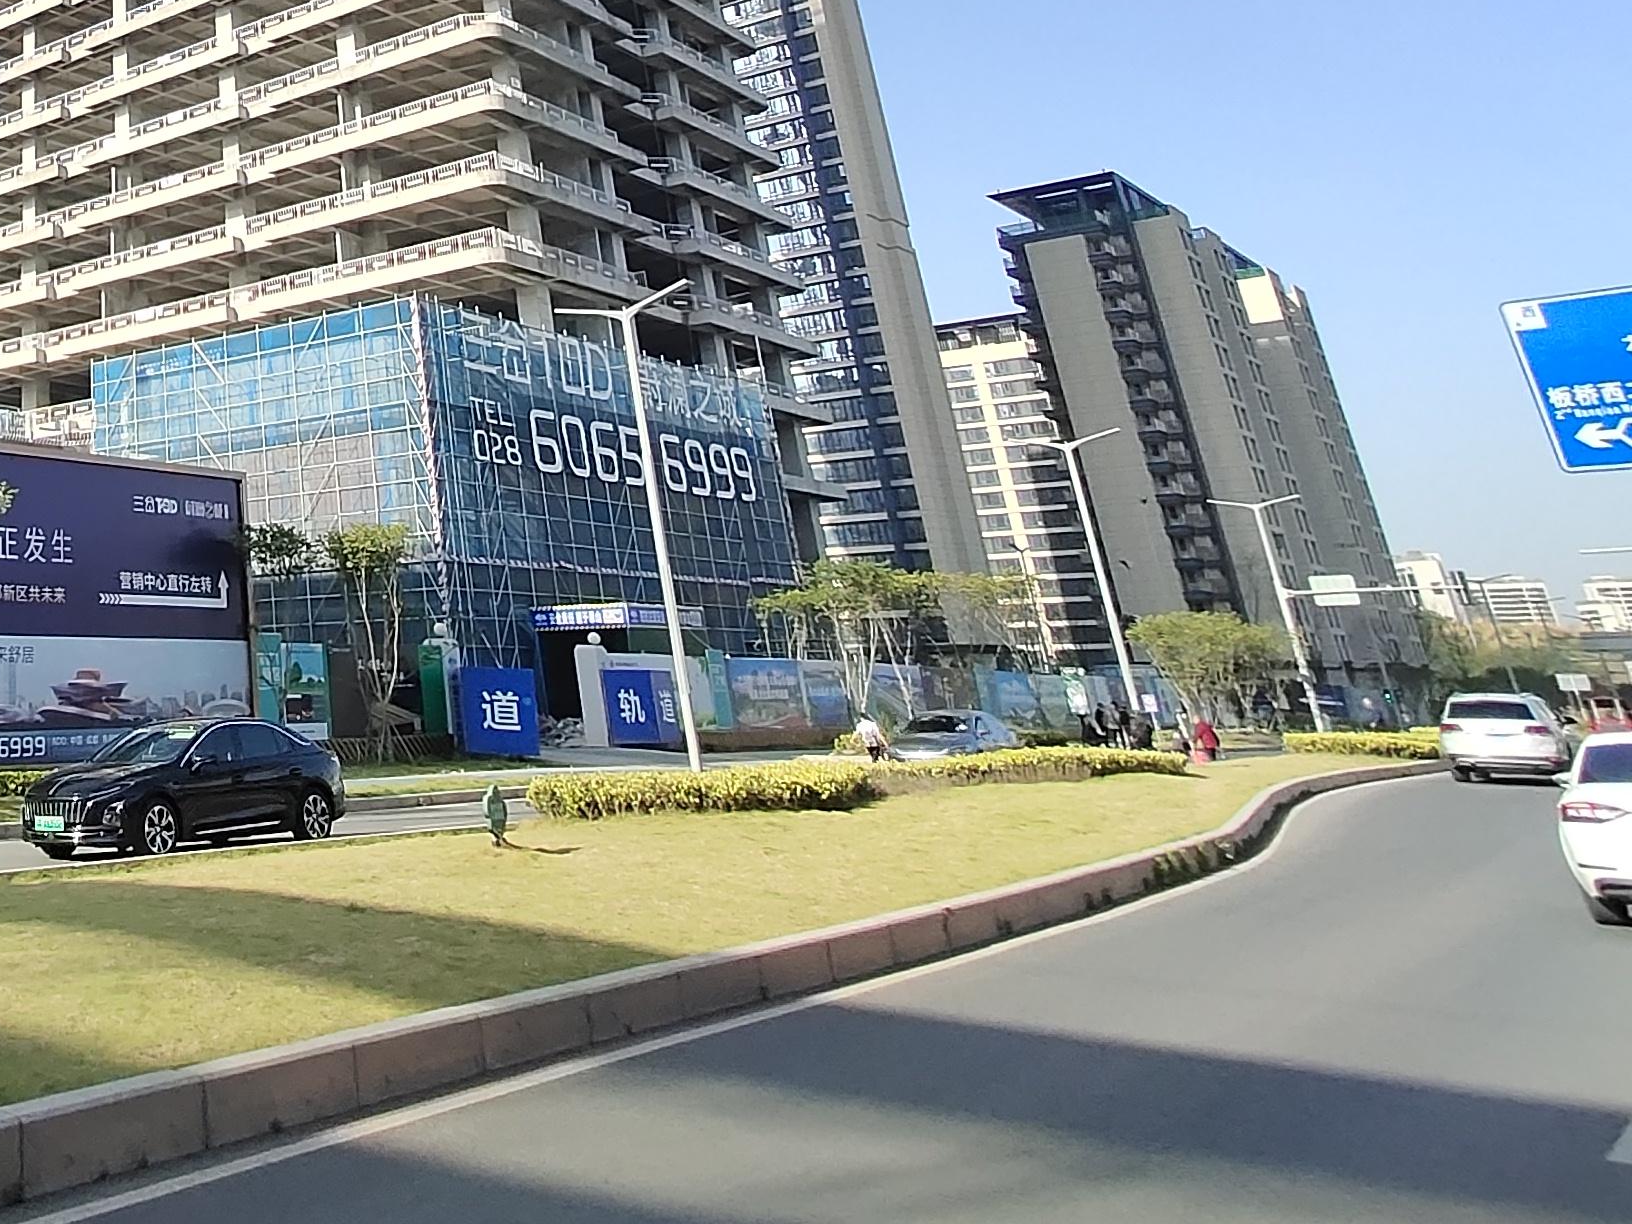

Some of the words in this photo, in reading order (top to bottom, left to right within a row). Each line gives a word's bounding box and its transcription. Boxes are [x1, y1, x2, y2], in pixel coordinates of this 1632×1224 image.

[469, 396, 513, 427] TEL
[472, 430, 522, 466] 028
[529, 409, 646, 487] 6065
[659, 433, 757, 502] 6999
[119, 571, 213, 593] 营销中心直行左转
[481, 690, 522, 732] 道
[617, 688, 646, 724] 轨
